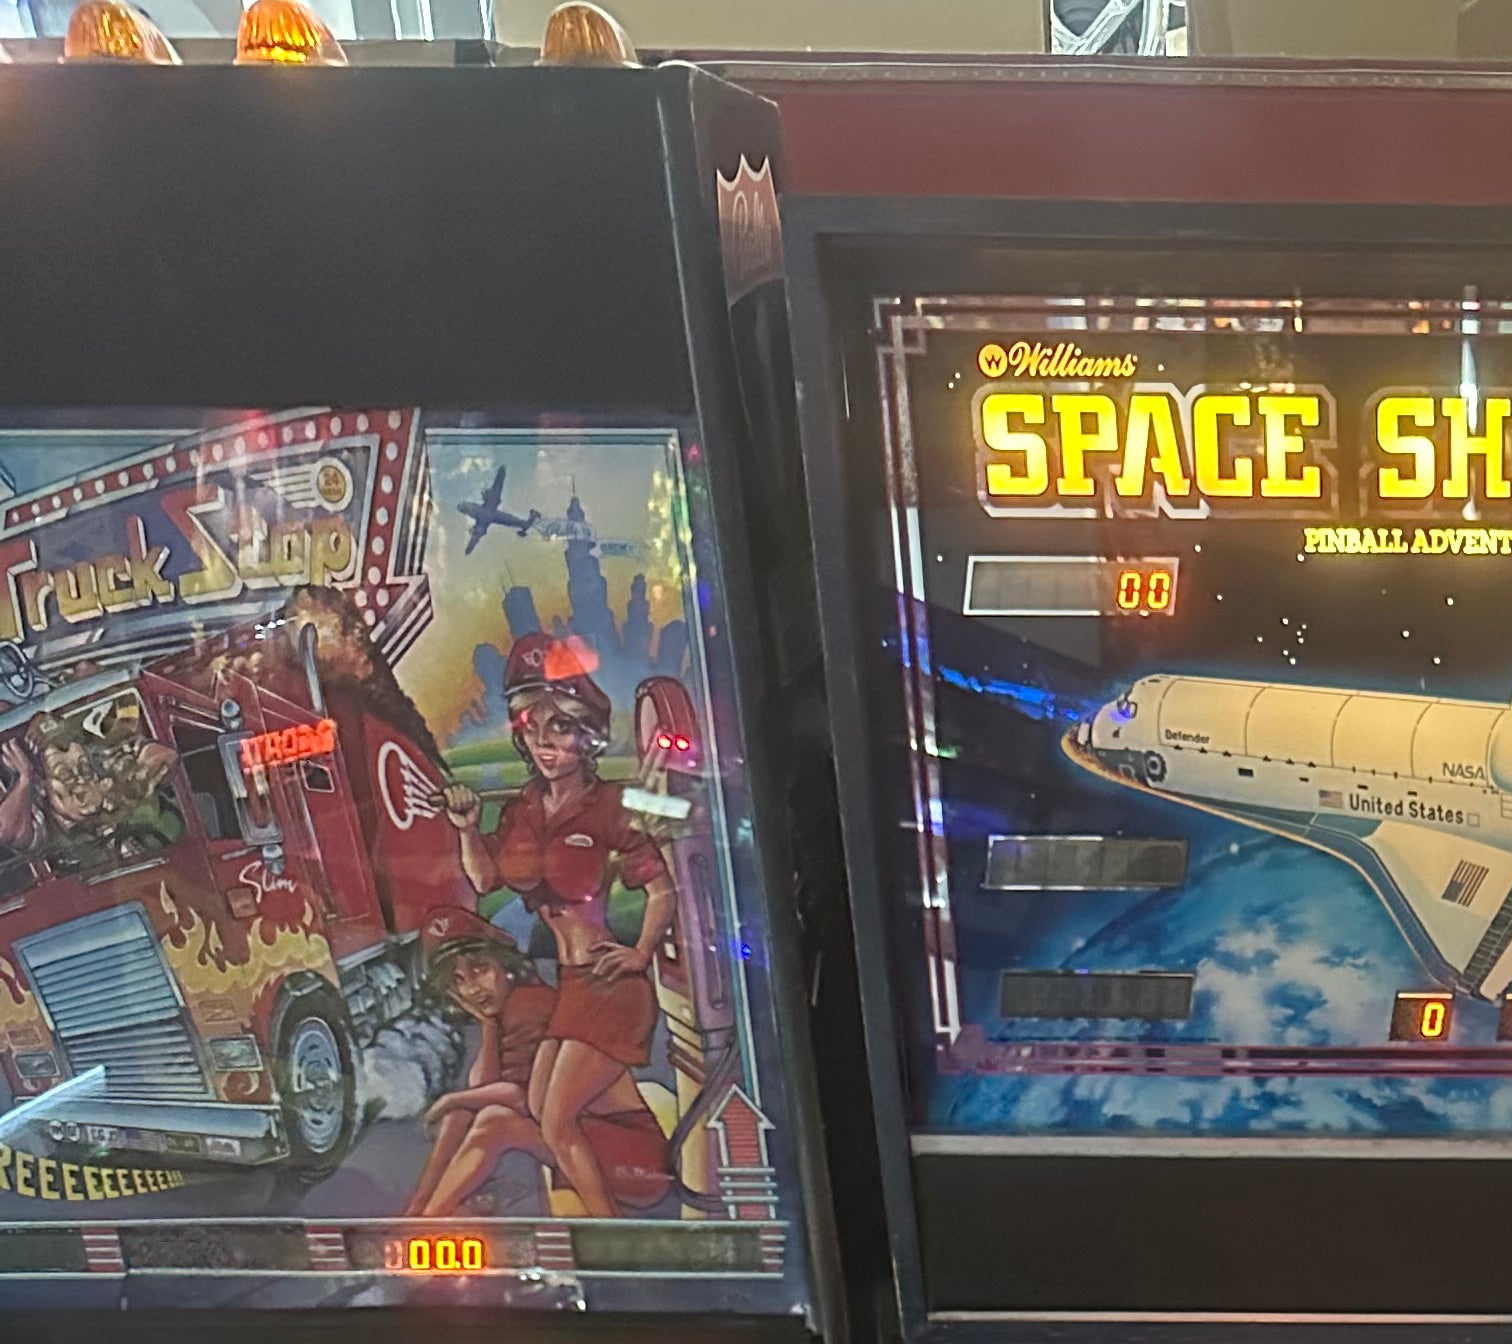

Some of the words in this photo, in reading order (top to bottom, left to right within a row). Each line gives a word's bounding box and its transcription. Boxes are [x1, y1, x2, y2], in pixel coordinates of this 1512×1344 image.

[1009, 342, 1138, 377] Williams
[982, 392, 1323, 498] SPACE
[323, 469, 340, 487] 24
[1303, 527, 1408, 554] PINBALL
[1117, 570, 1172, 611] 00
[1164, 728, 1211, 745] Defender
[1442, 761, 1486, 780] NASA
[1349, 794, 1404, 817] United
[1408, 801, 1465, 825] States
[238, 860, 298, 904] Slim
[1421, 1001, 1445, 1038] 0
